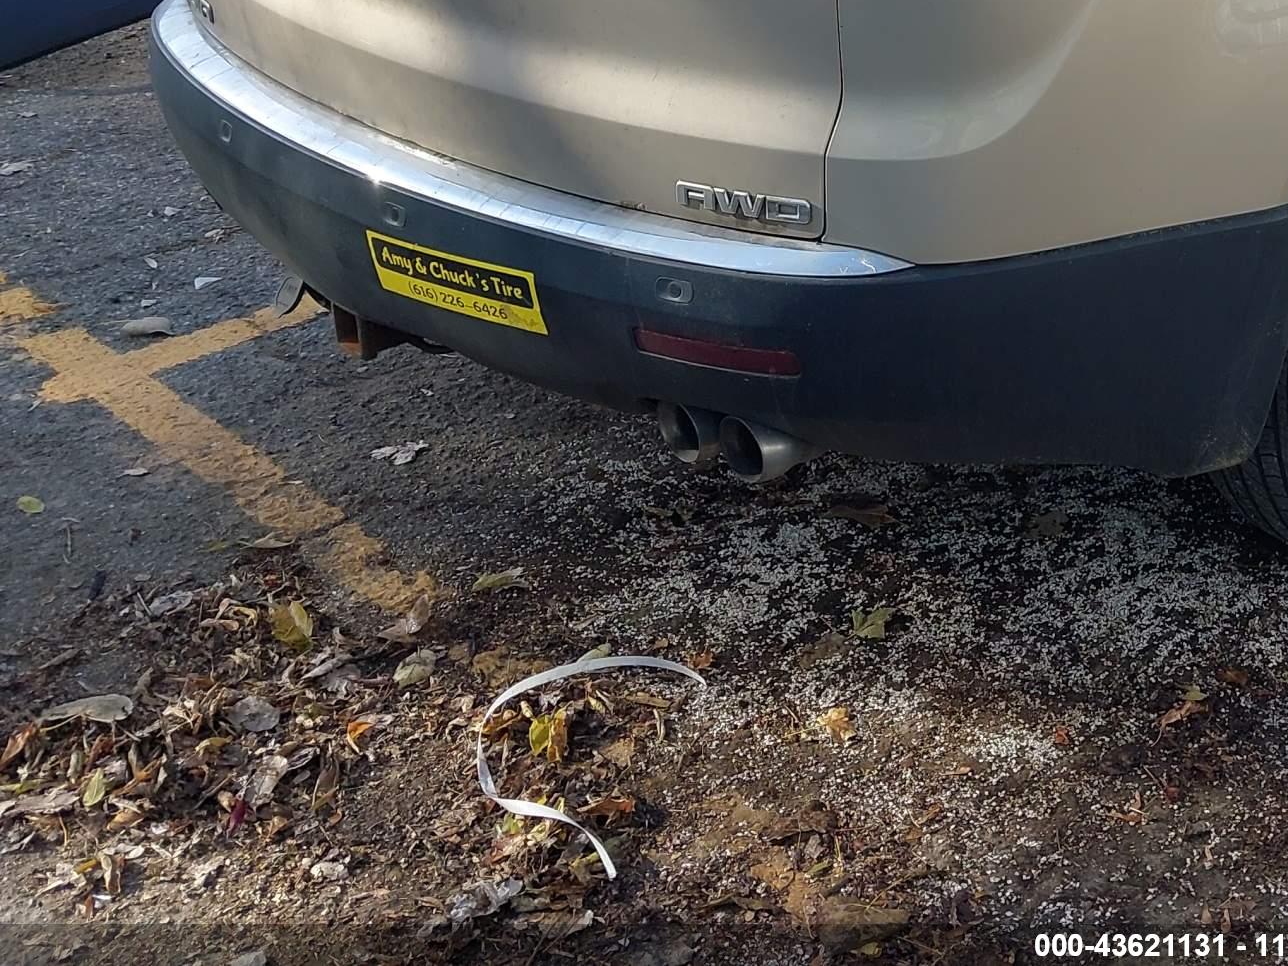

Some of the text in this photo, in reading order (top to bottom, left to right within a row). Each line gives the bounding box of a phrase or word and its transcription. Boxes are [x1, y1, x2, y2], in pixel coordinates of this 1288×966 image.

[676, 180, 813, 225] AWD
[381, 246, 523, 299] Amy & Chuck's Tire
[408, 281, 508, 320] (616) 226-6426
